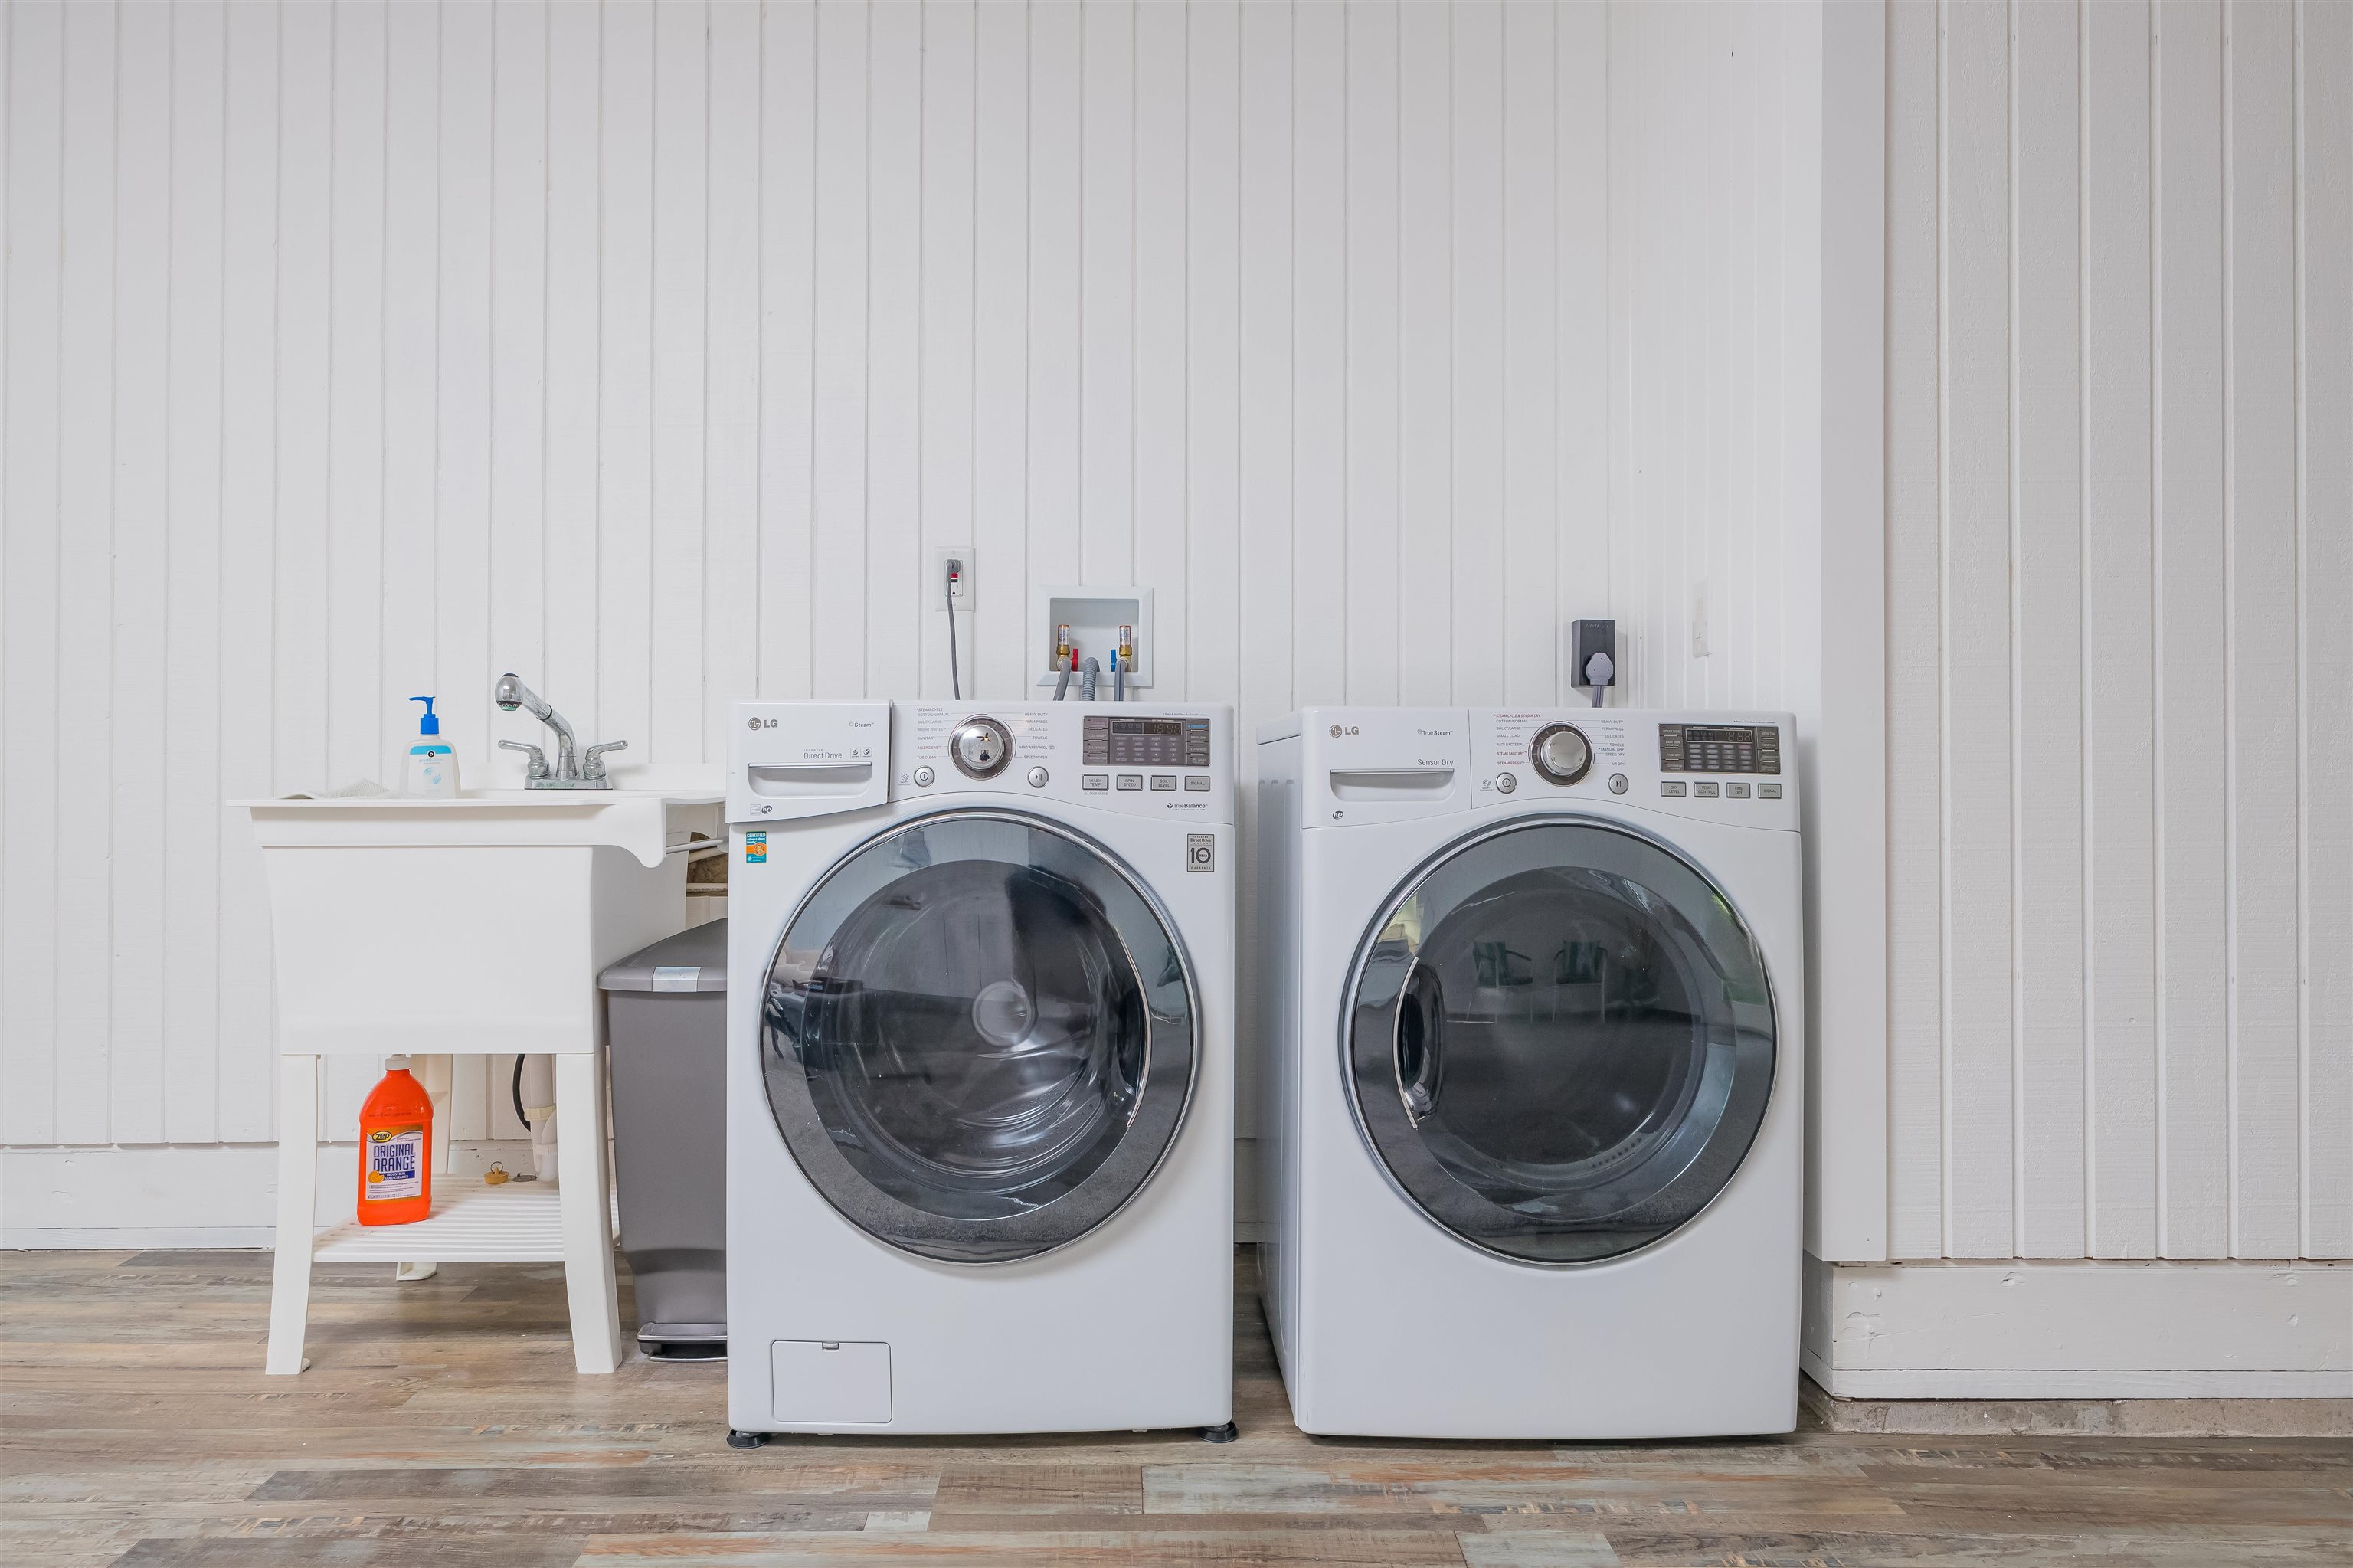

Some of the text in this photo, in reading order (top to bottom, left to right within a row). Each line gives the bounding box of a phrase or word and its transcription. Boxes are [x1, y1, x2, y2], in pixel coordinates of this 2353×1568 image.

[764, 719, 778, 728] LG
[1344, 726, 1360, 735] LG
[1190, 847, 1211, 864] 10
[374, 1143, 415, 1158] ORIGINAL
[374, 1155, 415, 1172] ORANGE
